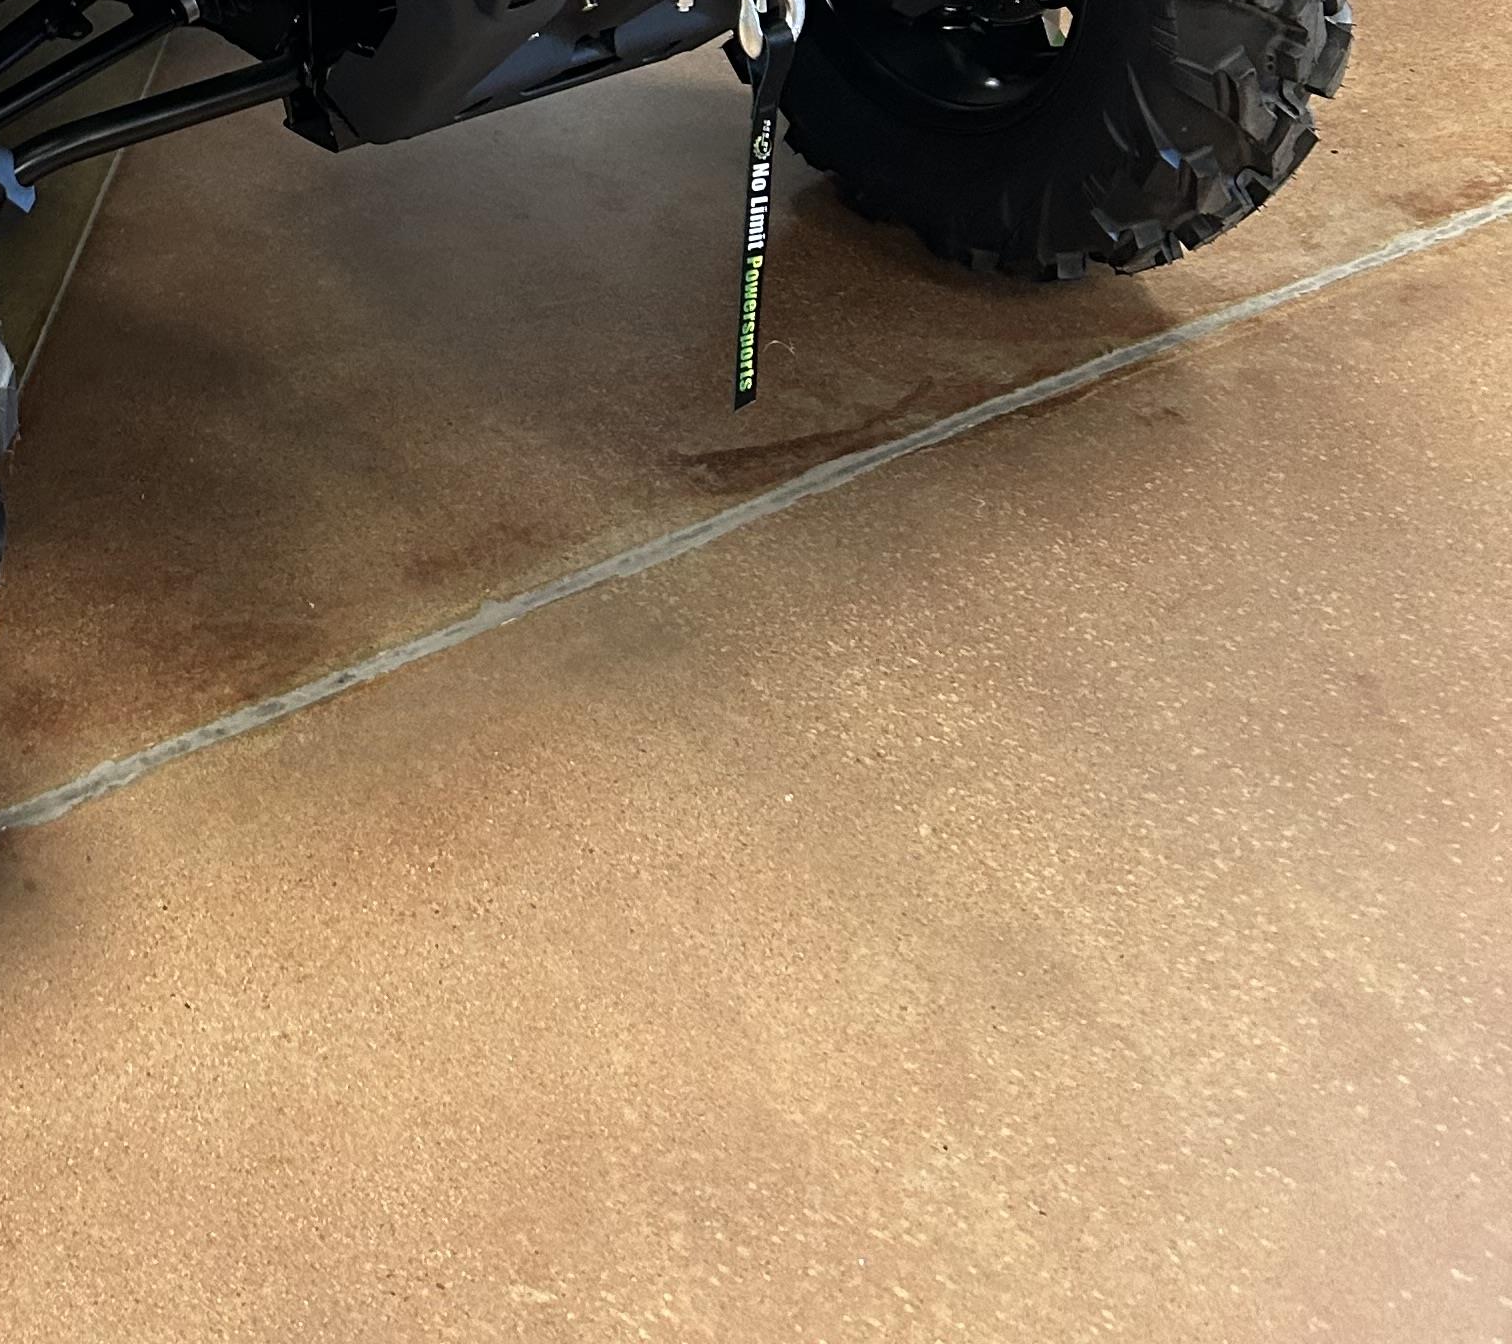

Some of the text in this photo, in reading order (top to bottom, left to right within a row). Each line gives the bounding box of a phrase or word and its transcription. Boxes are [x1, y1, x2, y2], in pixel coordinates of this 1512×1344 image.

[739, 162, 770, 393] No Limit Powersports
